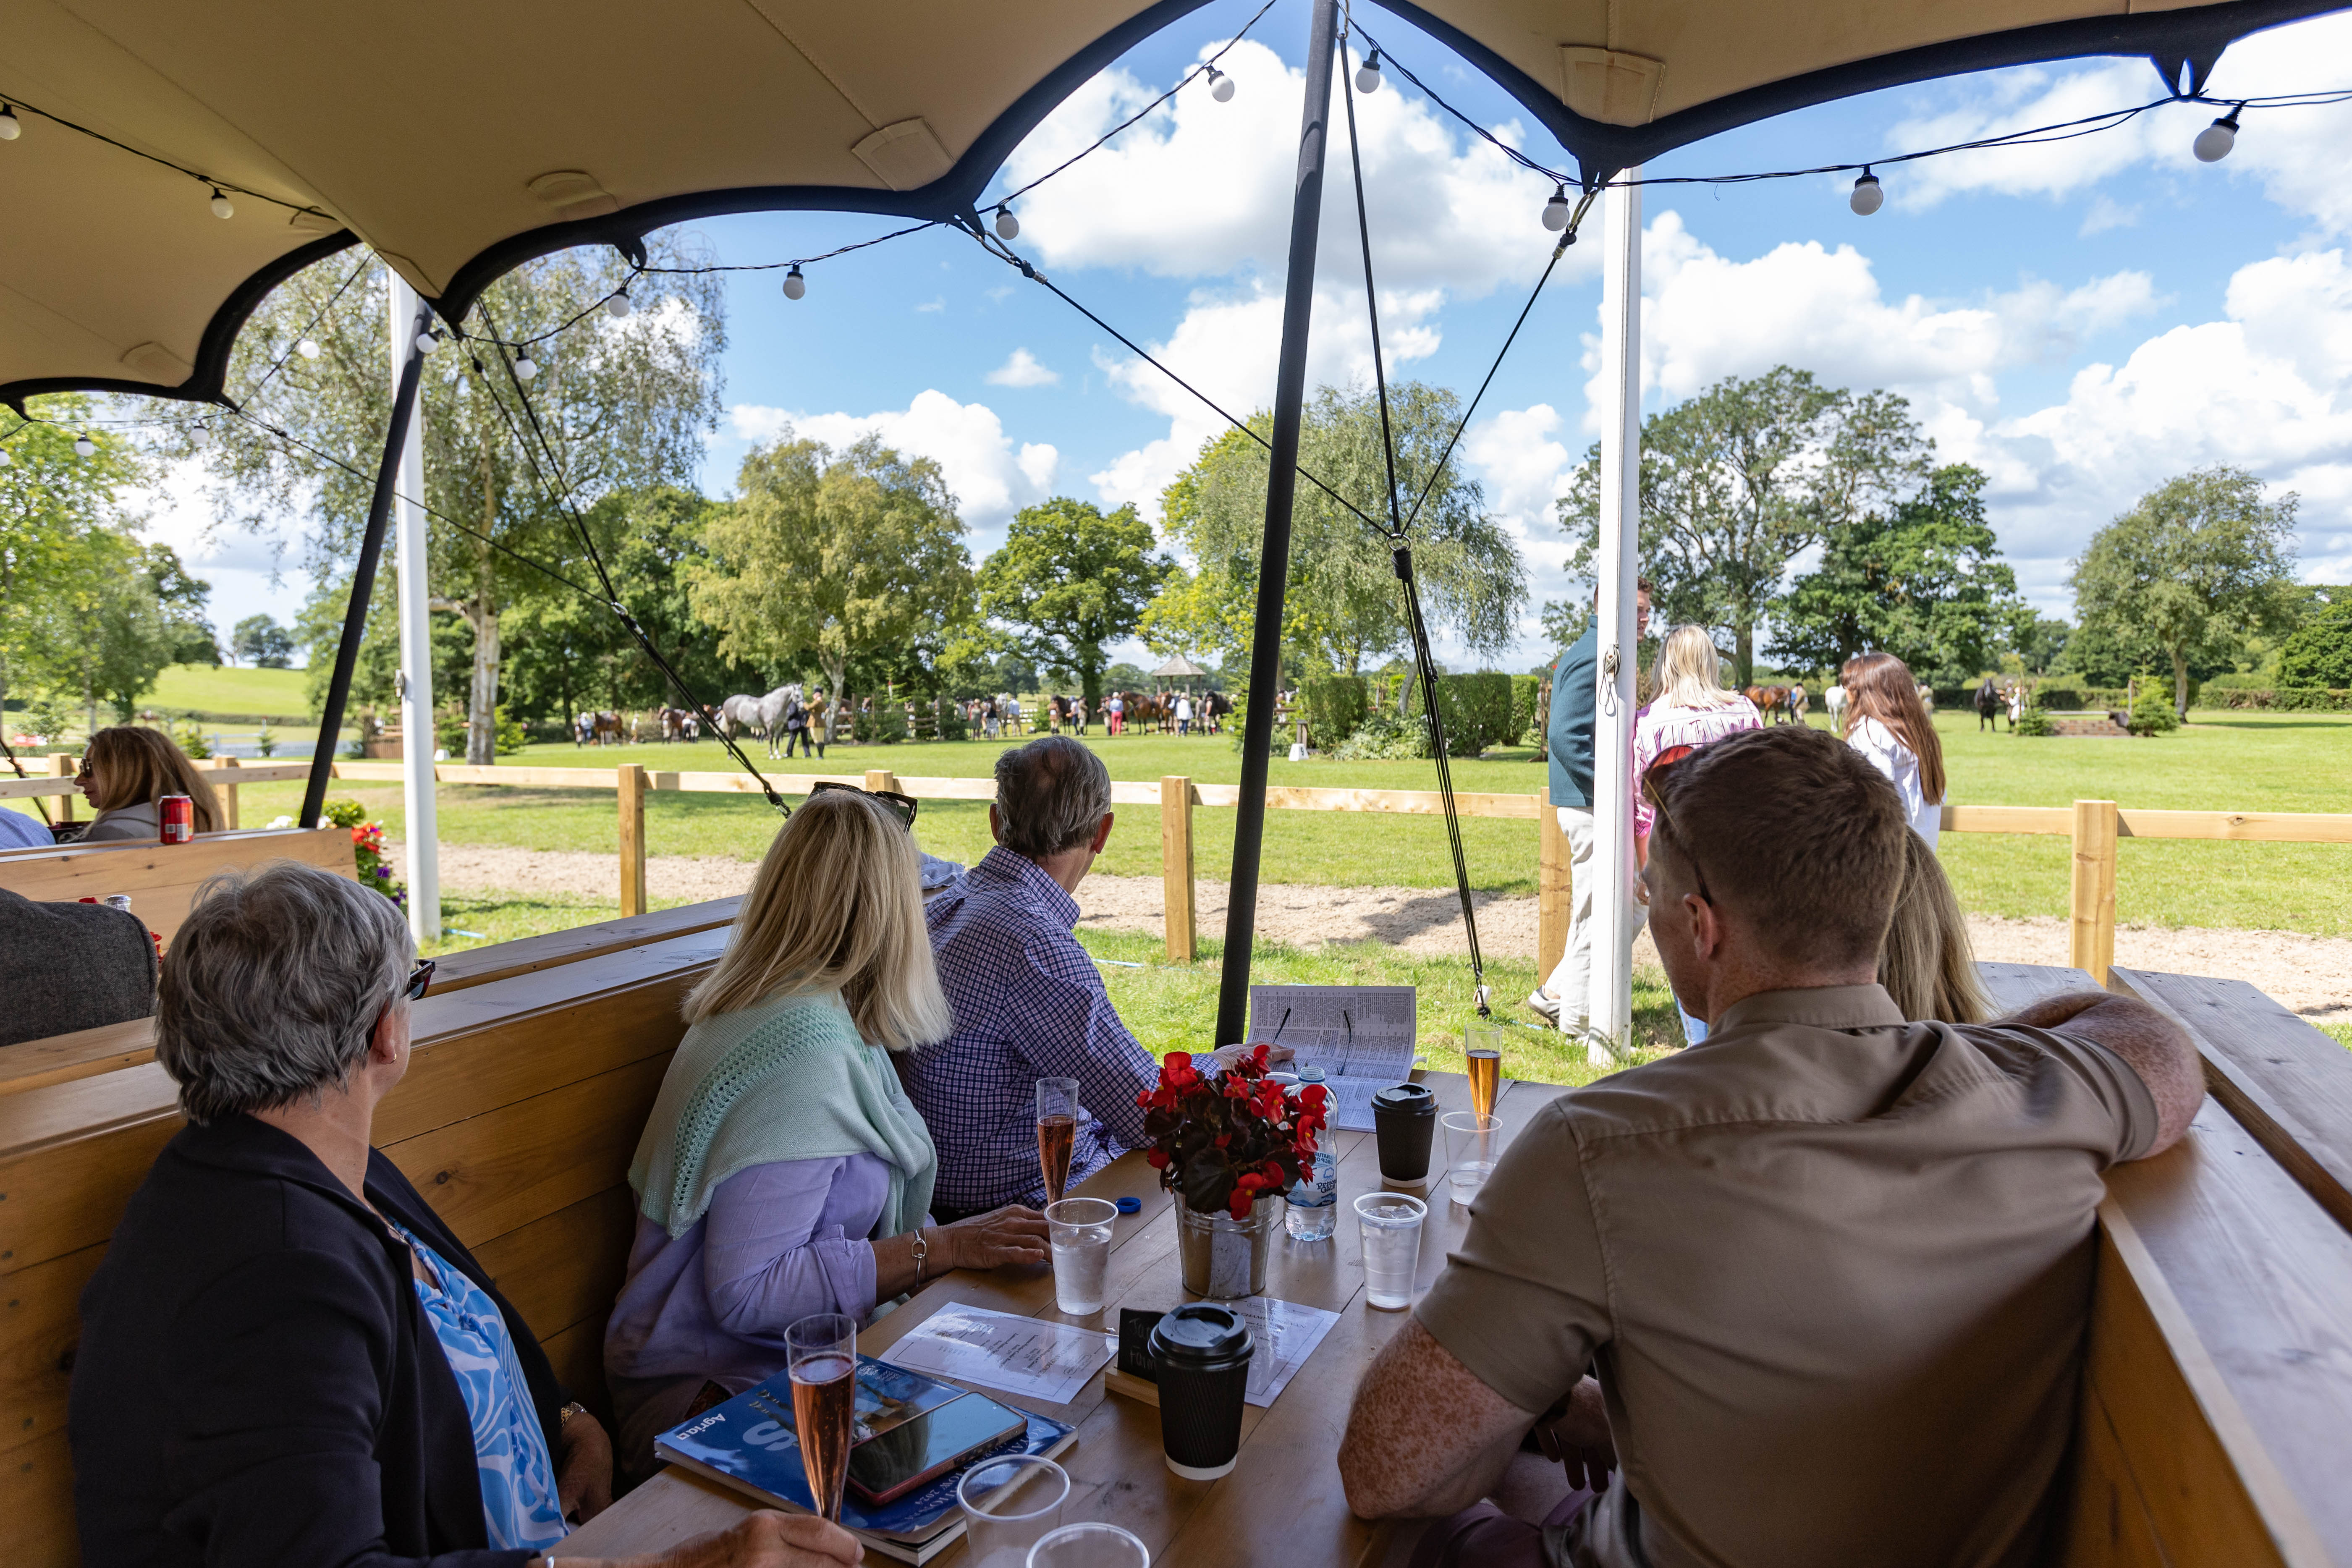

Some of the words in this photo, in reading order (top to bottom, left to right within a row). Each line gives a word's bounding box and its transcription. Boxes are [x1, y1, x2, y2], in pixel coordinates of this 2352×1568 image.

[1301, 747, 1304, 756] 9
[686, 1413, 726, 1434] Agria
[1007, 1426, 1046, 1454] ROYAL
